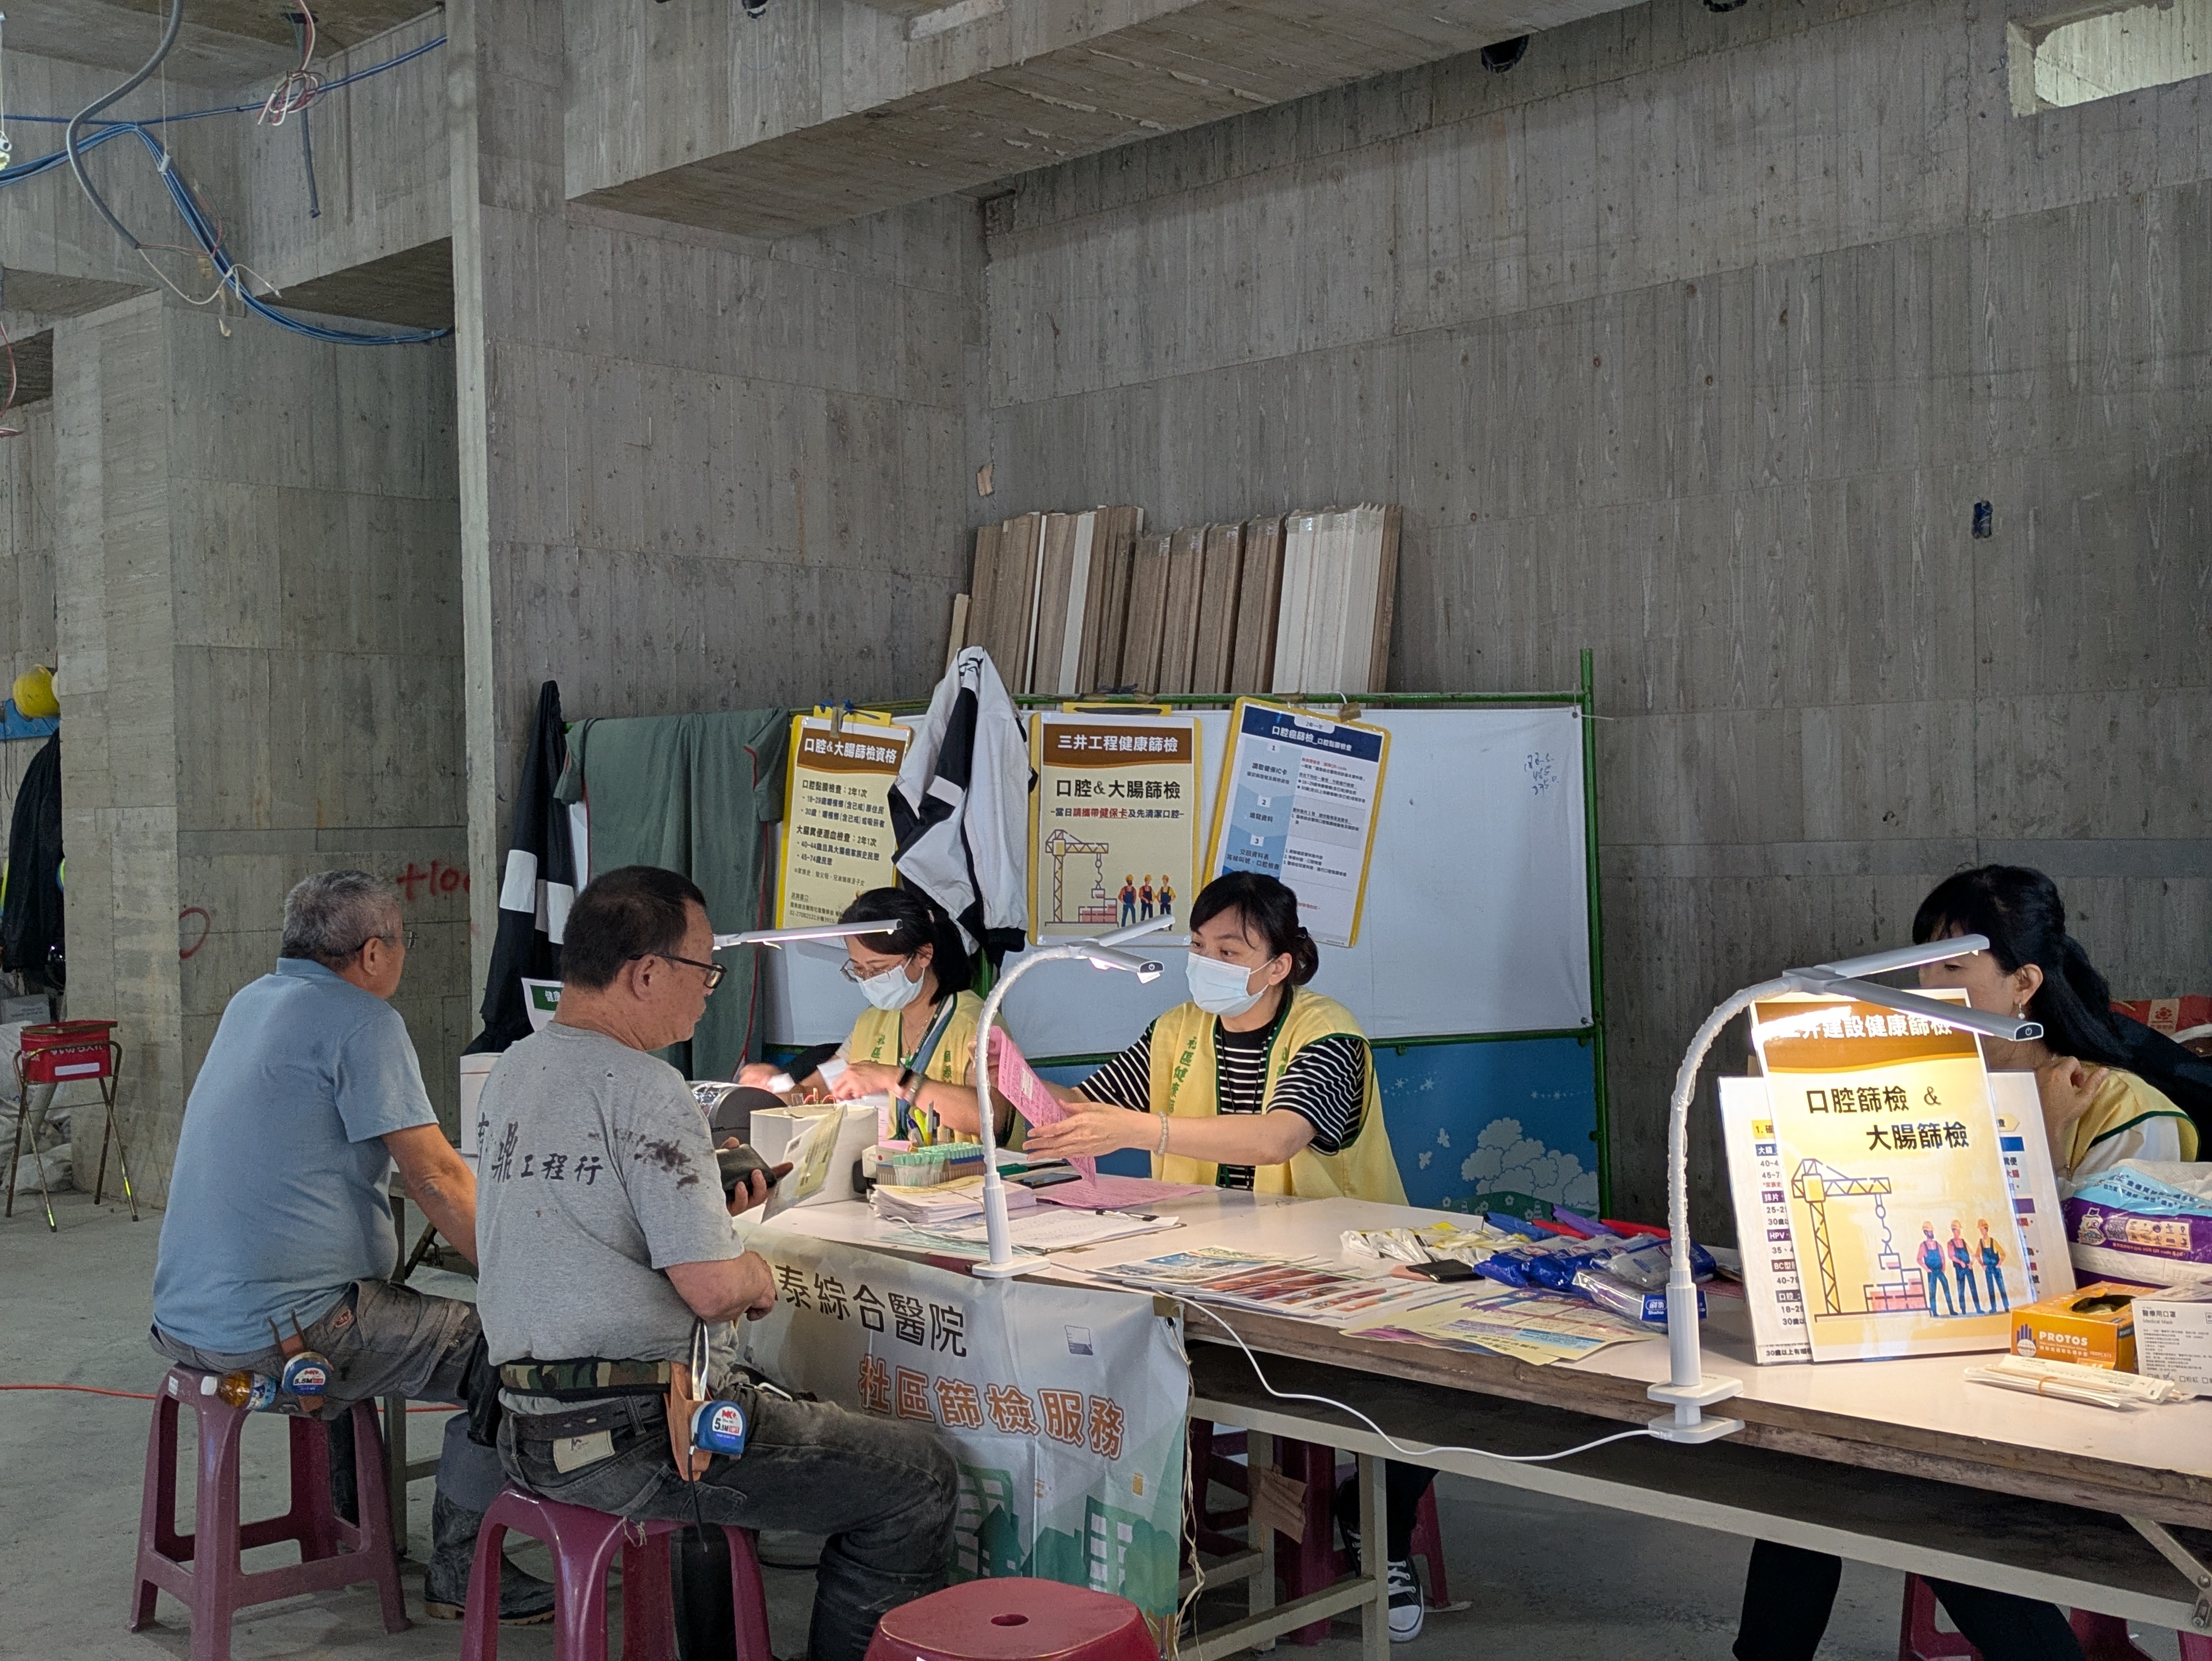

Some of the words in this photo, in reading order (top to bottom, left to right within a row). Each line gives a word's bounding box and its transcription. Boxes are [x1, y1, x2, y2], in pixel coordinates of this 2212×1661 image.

[804, 738, 897, 764] 口腔&大腸篩檢資格
[1058, 735, 1179, 753] 三井工程健康篩檢
[1056, 779, 1182, 800] 口腔&大腸篩檢
[1806, 1085, 1909, 1114] 口腔篩檢
[1924, 1086, 1942, 1107] &
[1866, 1121, 1970, 1151] 大腸篩檢
[775, 1264, 967, 1357] 泰綜合醫院
[2039, 1331, 2088, 1346] PROTOS
[858, 1353, 1125, 1461] 社區篩檢服務
